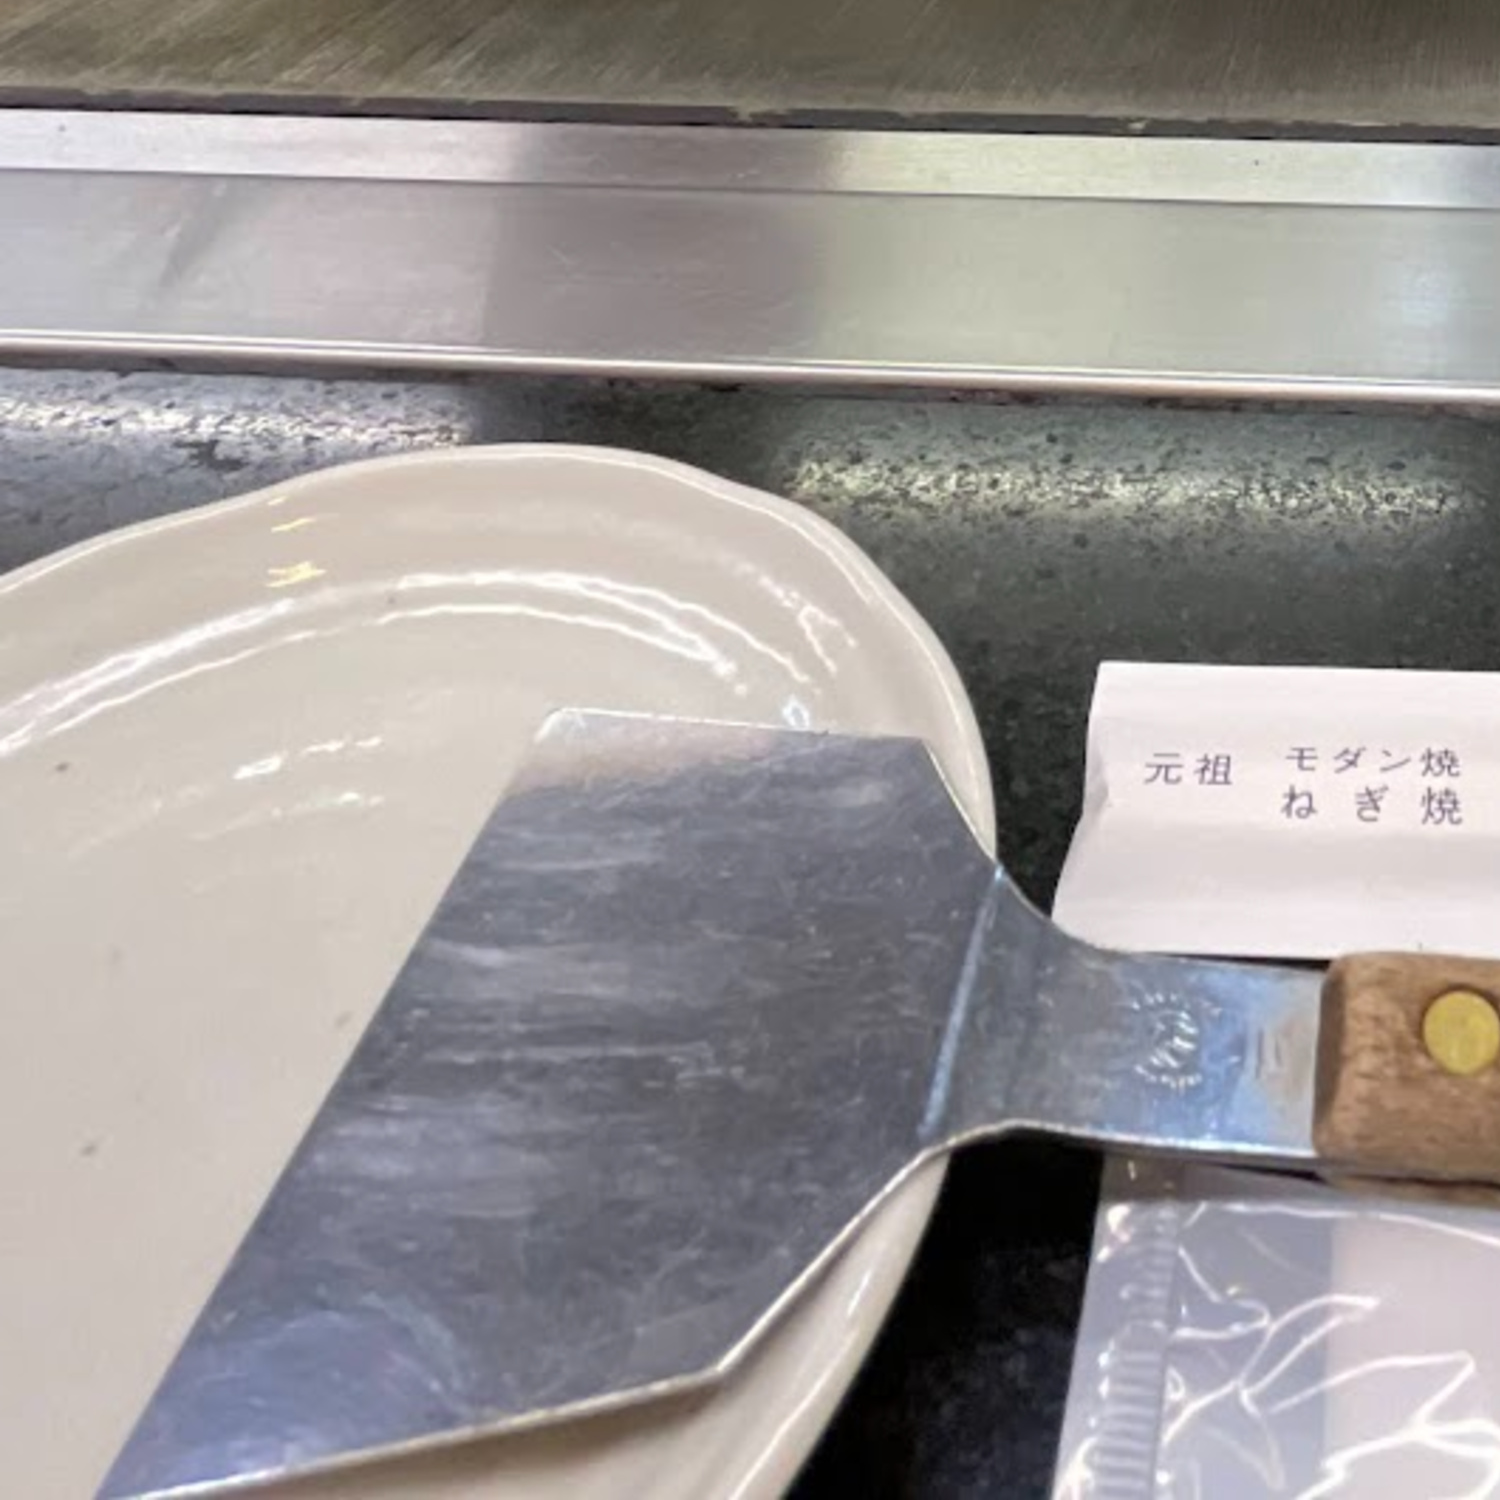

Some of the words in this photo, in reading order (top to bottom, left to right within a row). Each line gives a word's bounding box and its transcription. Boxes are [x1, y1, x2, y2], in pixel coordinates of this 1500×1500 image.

[1143, 752, 1233, 786] 元祖
[1285, 746, 1461, 778] モダン焼
[1280, 784, 1464, 826] ねぎ焼
